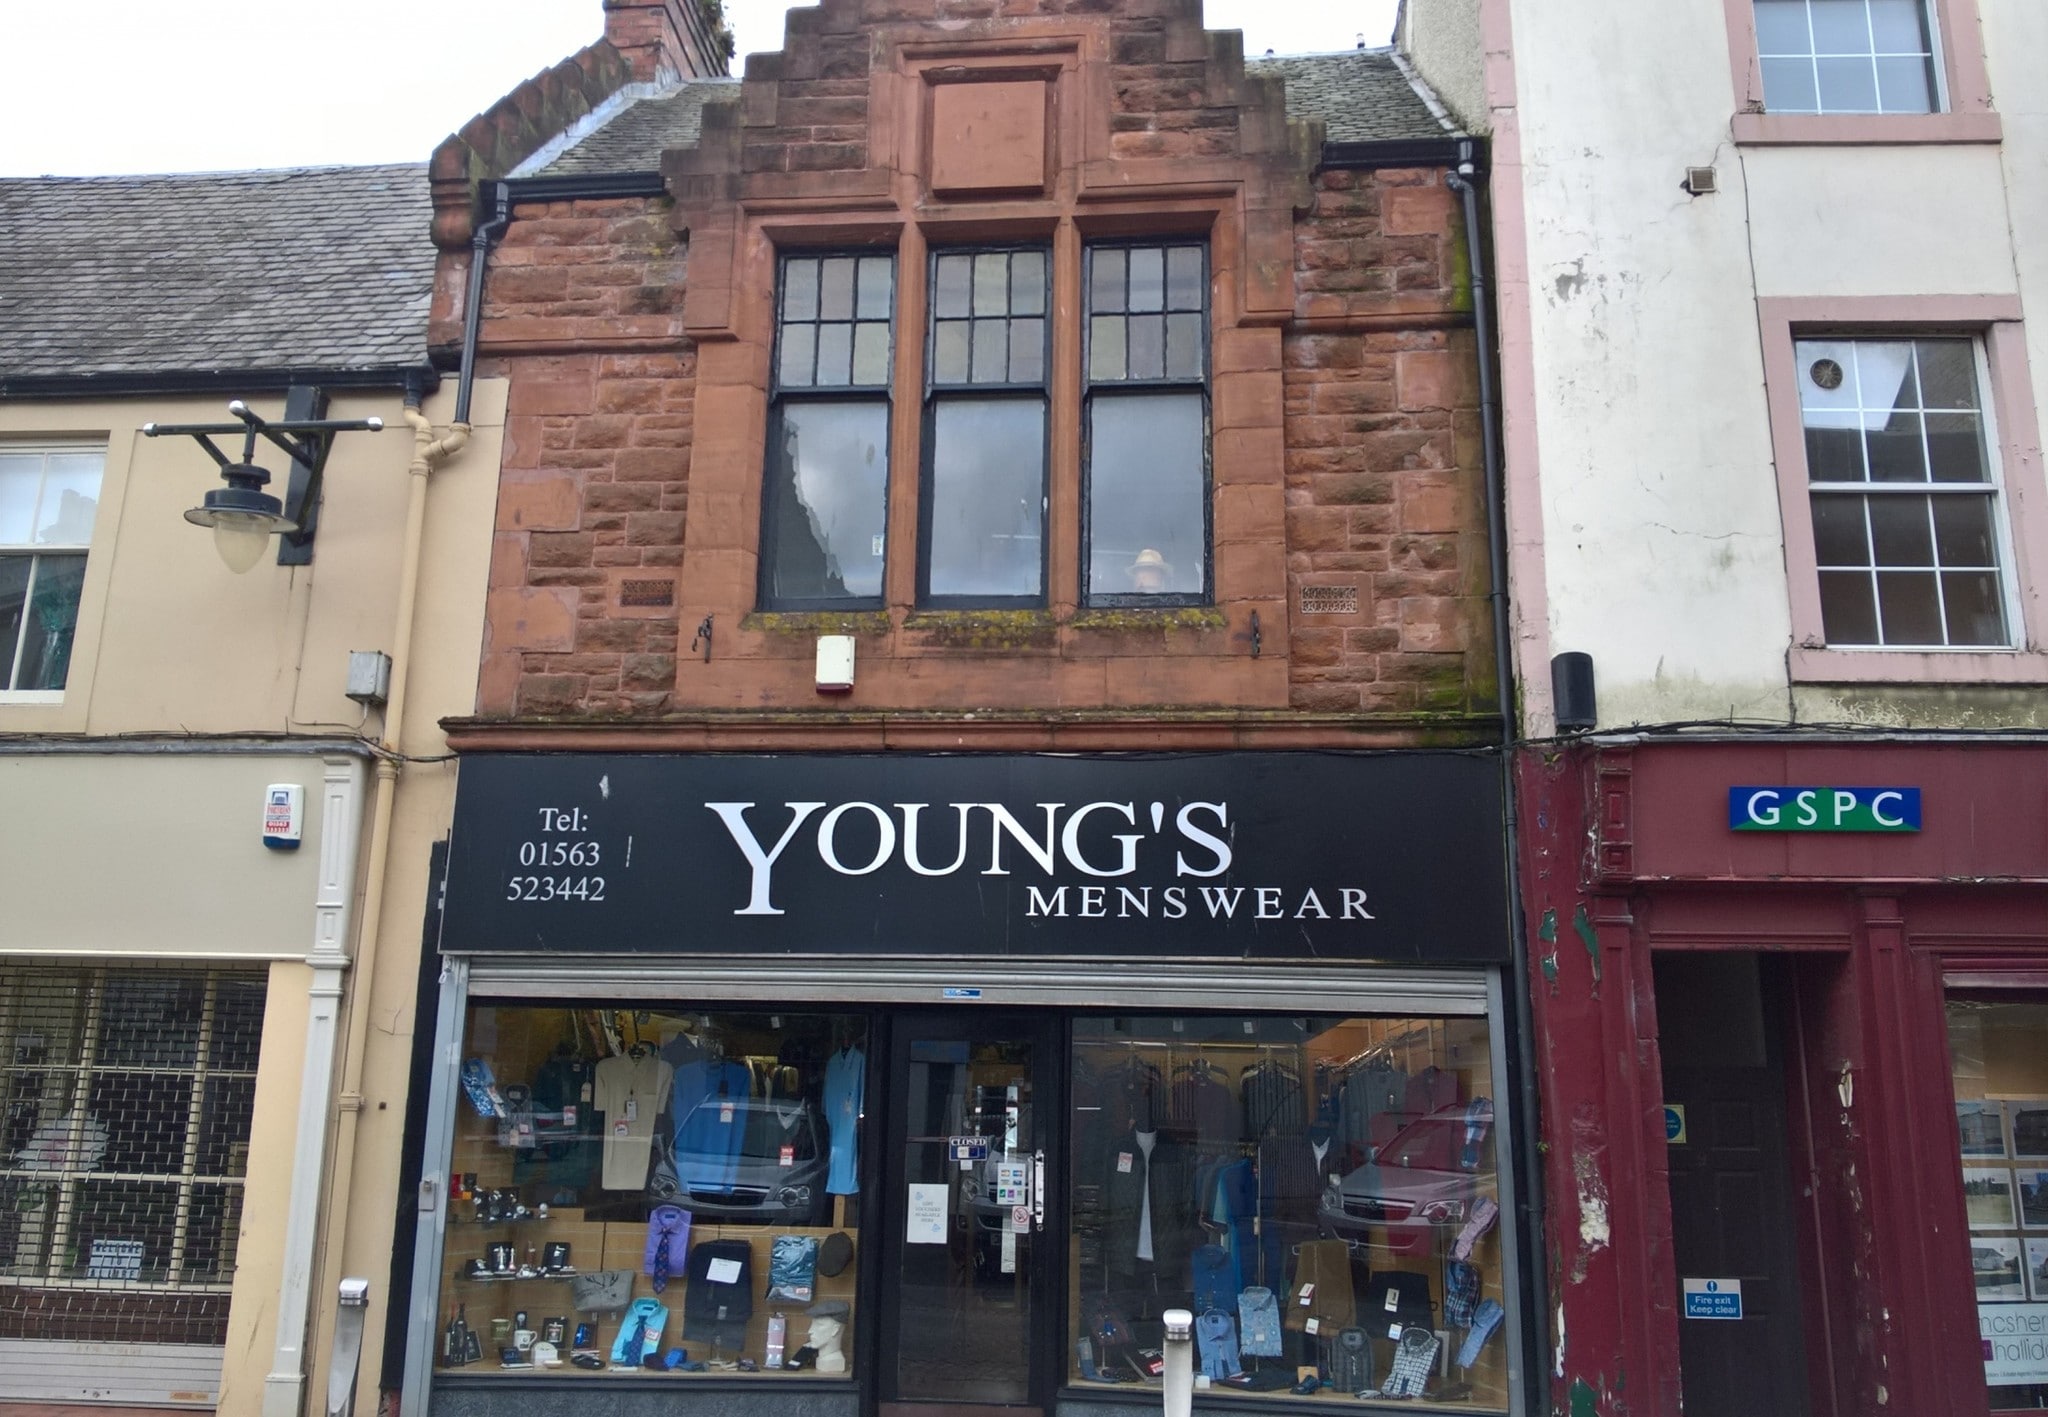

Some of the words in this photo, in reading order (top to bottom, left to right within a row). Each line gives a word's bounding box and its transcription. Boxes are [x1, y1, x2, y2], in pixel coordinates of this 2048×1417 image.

[539, 807, 588, 832] Tel:
[519, 841, 600, 866] 01563
[704, 801, 1232, 915] YOUNG'S
[506, 876, 605, 901] 523442
[1025, 886, 1375, 921] MENSWEAR
[951, 1138, 986, 1146] CLOSED
[1690, 1305, 1713, 1315] Keep
[1715, 1305, 1737, 1314] clear
[1695, 1296, 1712, 1305] Fire
[1715, 1296, 1731, 1305] exit
